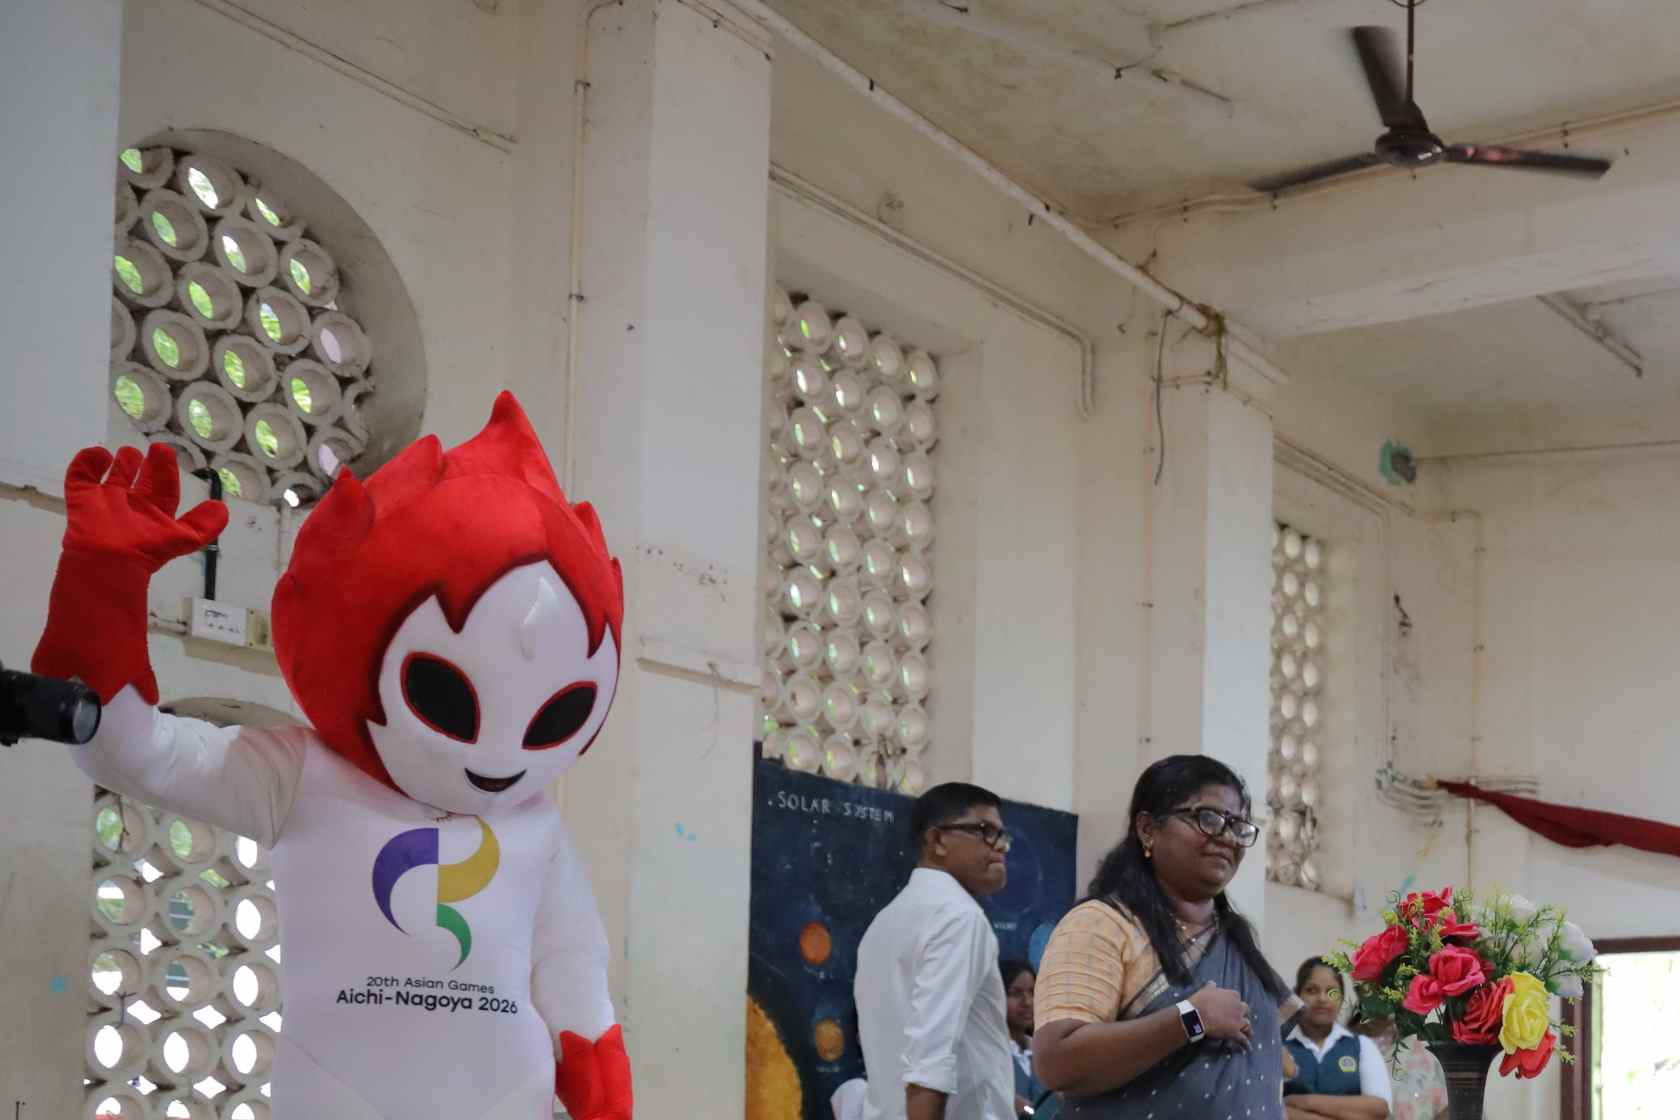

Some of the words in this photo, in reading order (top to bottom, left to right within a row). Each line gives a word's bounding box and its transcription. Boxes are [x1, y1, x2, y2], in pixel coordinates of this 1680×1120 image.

[777, 790, 831, 814] SOLAR
[843, 801, 896, 823] SYSTEM
[366, 976, 399, 988] 20th
[404, 977, 444, 990] Asian
[448, 979, 495, 994] Games
[336, 989, 473, 1013] Aichi-Nagoya
[478, 997, 519, 1014] 2026
